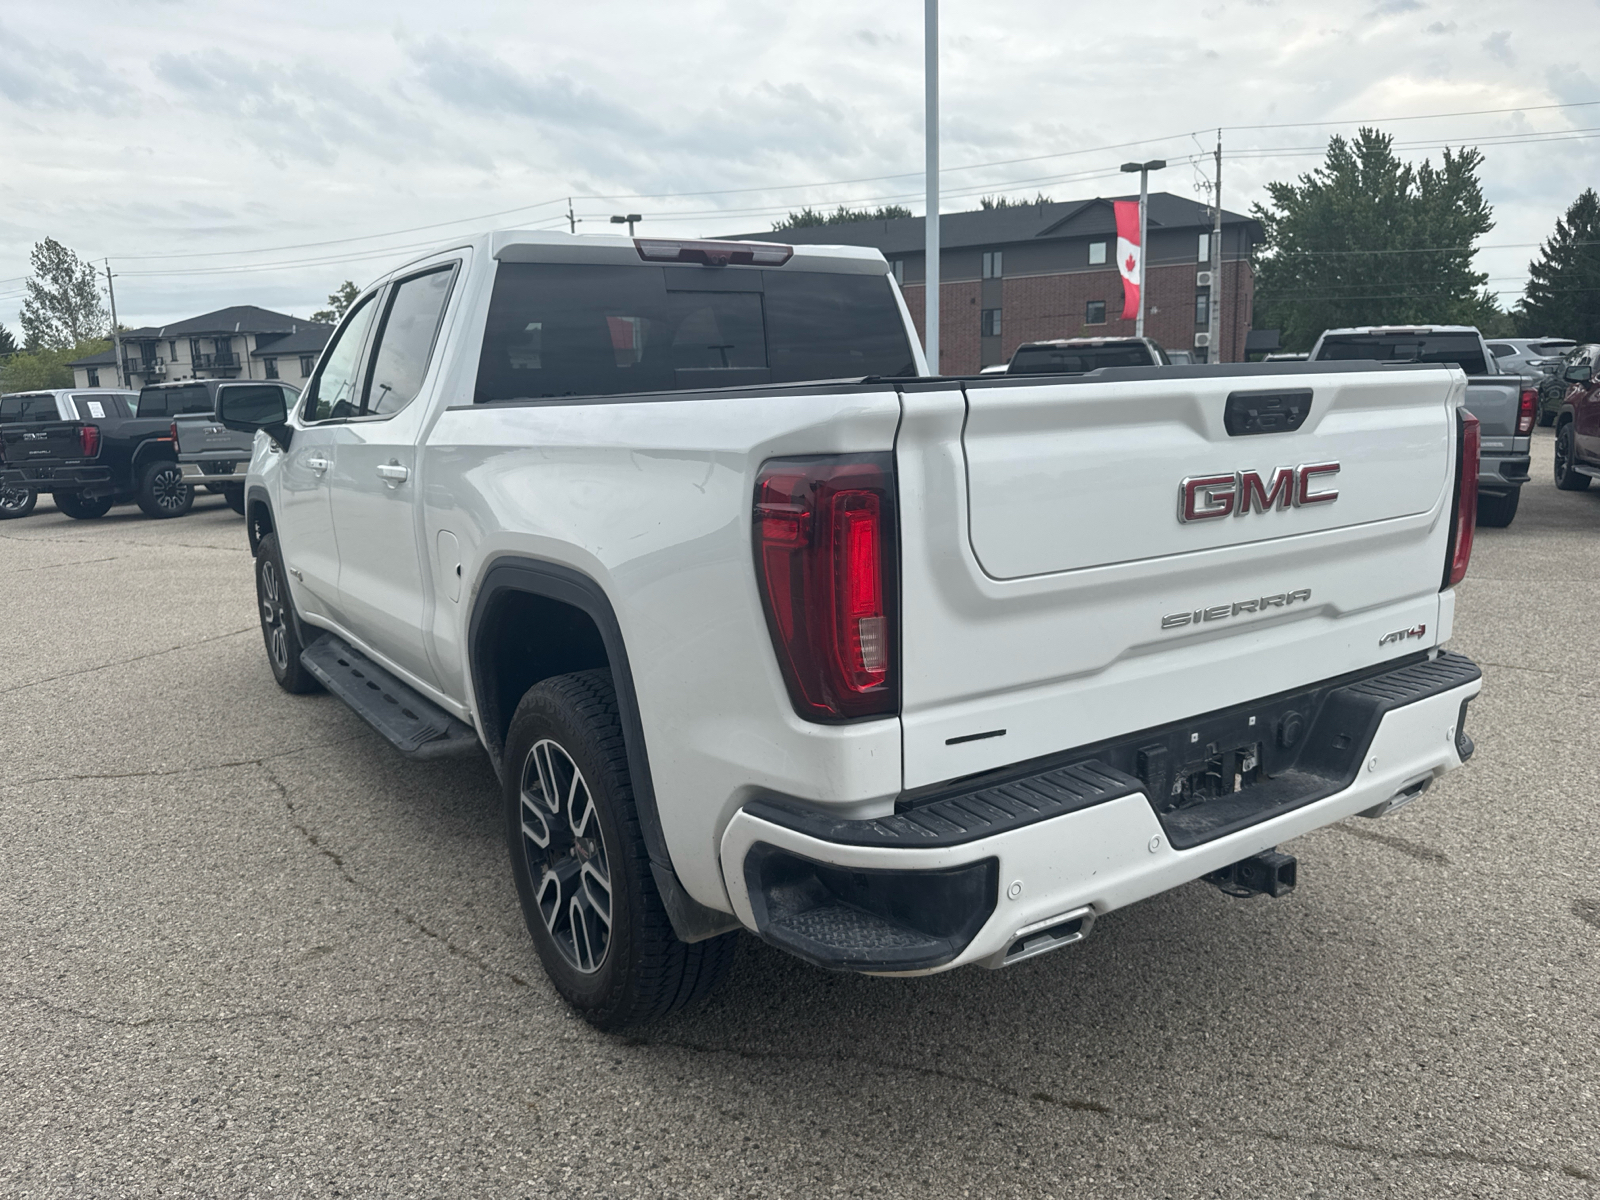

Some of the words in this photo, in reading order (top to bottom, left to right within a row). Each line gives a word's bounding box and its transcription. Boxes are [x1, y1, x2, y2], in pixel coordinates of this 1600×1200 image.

[1177, 460, 1341, 525] GMC
[1161, 588, 1312, 630] SIERRA
[1379, 623, 1426, 647] AT4
